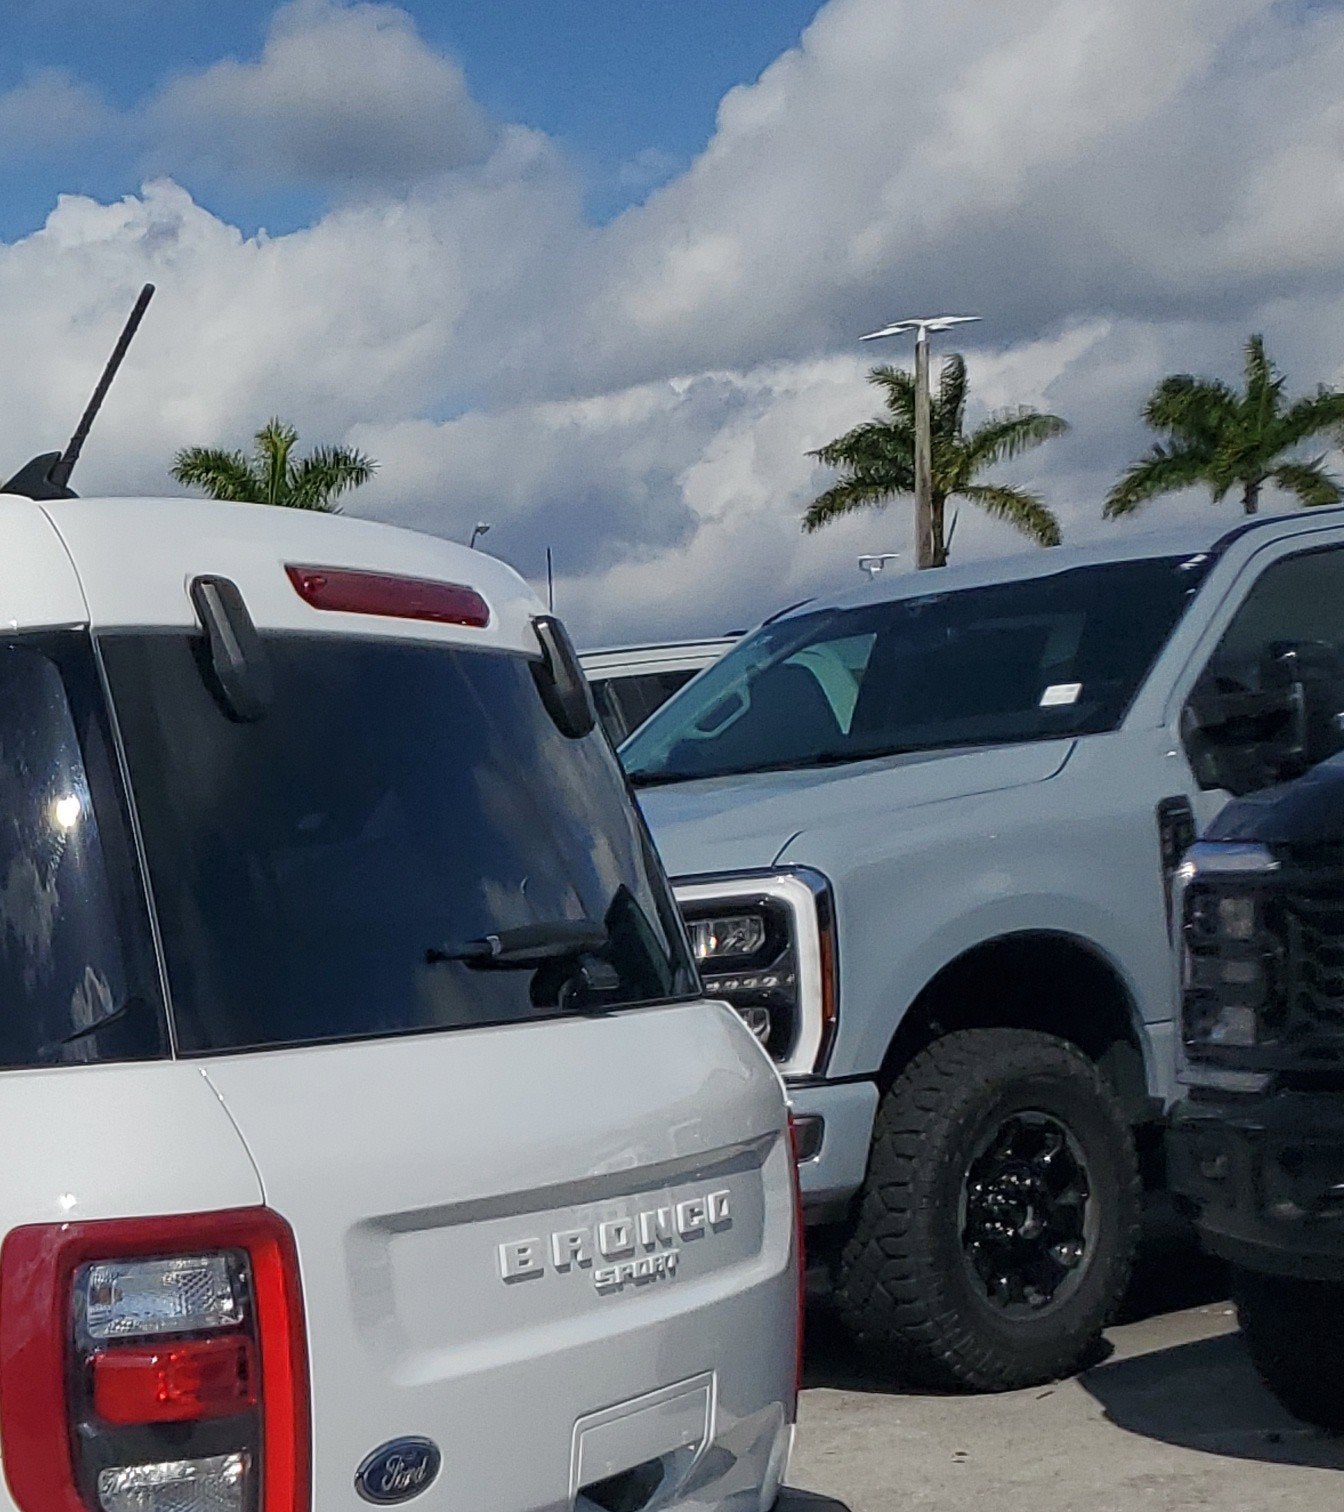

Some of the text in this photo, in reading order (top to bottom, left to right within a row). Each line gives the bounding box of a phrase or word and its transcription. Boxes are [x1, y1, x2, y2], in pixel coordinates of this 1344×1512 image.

[498, 1189, 732, 1284] BRONCO
[594, 1249, 680, 1295] SPORT
[381, 1454, 428, 1491] Ford
